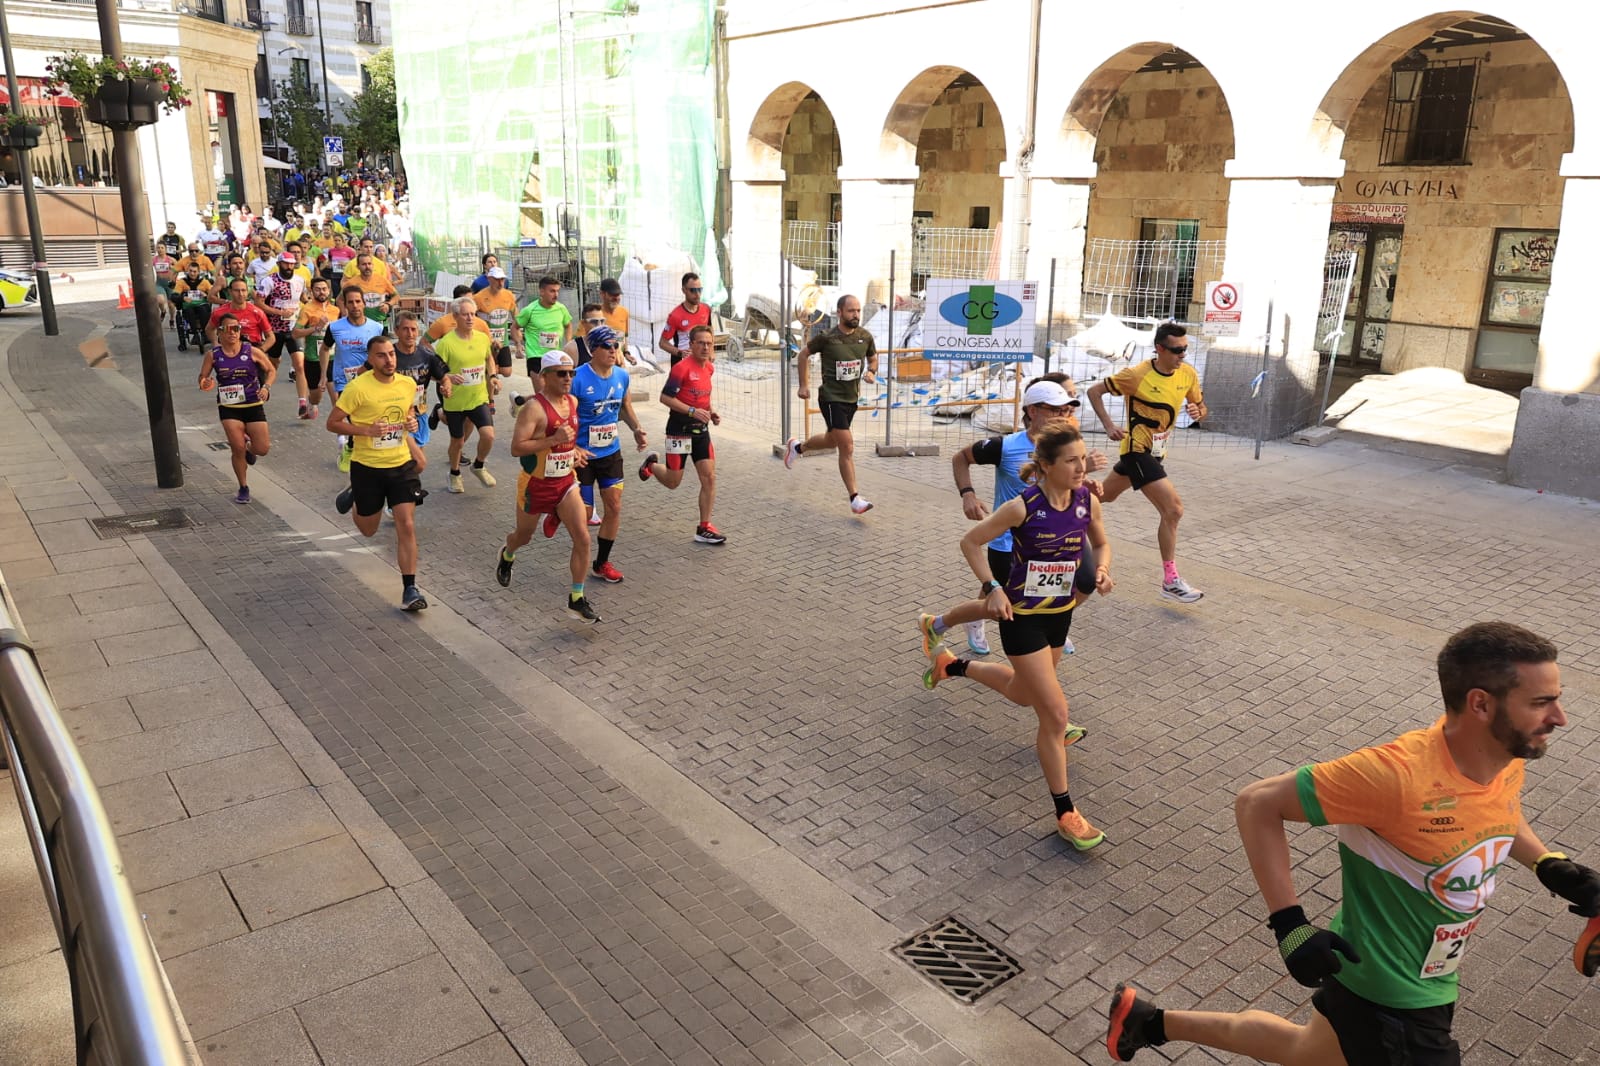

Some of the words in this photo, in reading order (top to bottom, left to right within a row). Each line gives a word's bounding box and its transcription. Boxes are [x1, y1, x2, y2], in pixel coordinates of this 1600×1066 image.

[1355, 204, 1408, 212] ADQUIRIDO
[961, 300, 1000, 321] CG
[937, 336, 1000, 348] CONGESA
[1003, 338, 1022, 349] XXI
[933, 352, 1025, 361] www.congesaxxi.com
[471, 372, 480, 381] 17
[225, 391, 239, 400] 127
[380, 431, 399, 441] 234
[598, 432, 614, 442] 145
[671, 440, 683, 449] 51
[1028, 562, 1075, 574] bedunia
[1036, 573, 1065, 588] 245
[1445, 939, 1463, 960] 2
